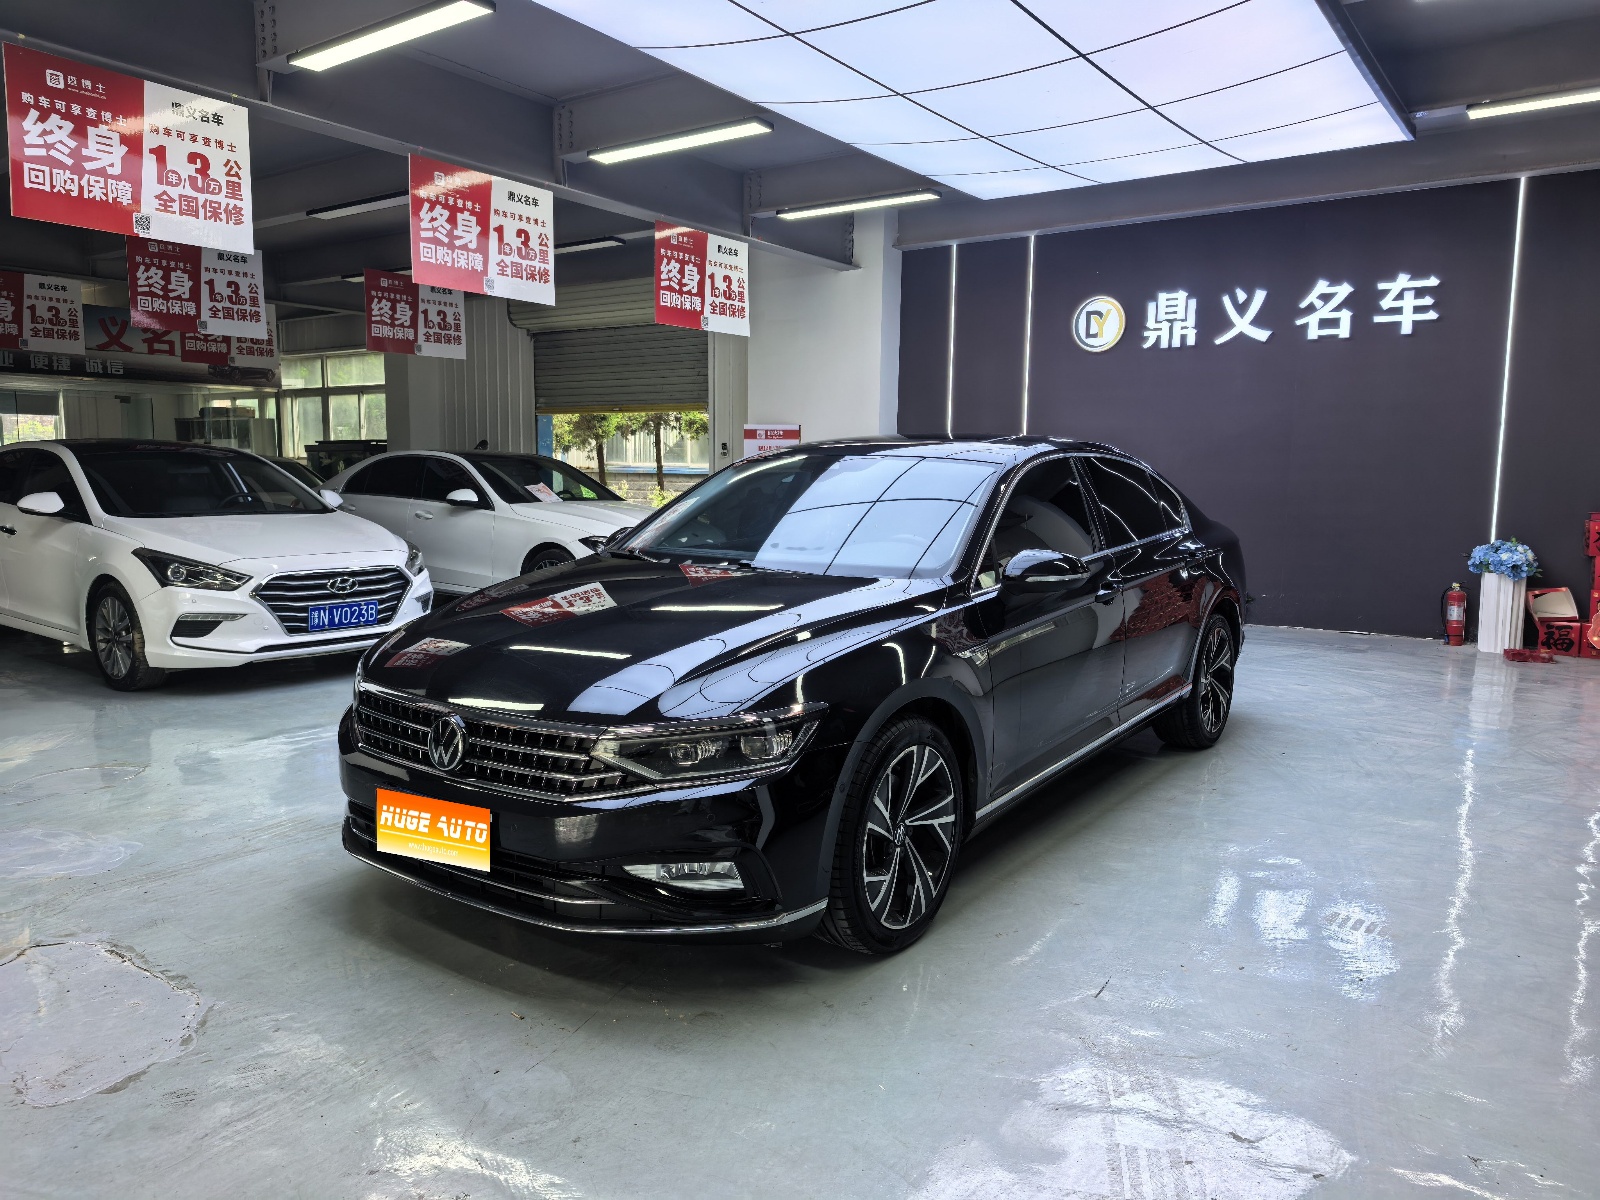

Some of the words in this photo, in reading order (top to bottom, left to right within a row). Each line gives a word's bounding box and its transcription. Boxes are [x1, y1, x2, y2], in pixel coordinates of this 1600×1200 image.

[22, 108, 129, 175] 终身
[23, 162, 133, 205] 回购保障
[154, 190, 244, 225] 全国保修
[507, 190, 539, 208] 鼎义名车
[419, 202, 481, 249] 终身
[419, 242, 484, 272] 回购保障
[136, 264, 193, 299] 终身
[496, 259, 550, 285] 全国保修
[660, 257, 700, 294] 终身
[137, 296, 197, 317] 回购保障
[371, 298, 413, 326] 终身
[660, 290, 702, 312] 回购保障
[709, 300, 746, 319] 全国保修
[1142, 272, 1441, 349] 鼎义名车
[208, 304, 262, 324] 全国保修
[30, 326, 80, 341] 全国保修
[371, 324, 415, 341] 回购保障
[422, 331, 462, 346] 全国保修
[186, 339, 228, 354] 回购保障
[236, 345, 275, 357] 全国保修
[85, 357, 124, 374] 诚信
[1541, 623, 1575, 652] 福
